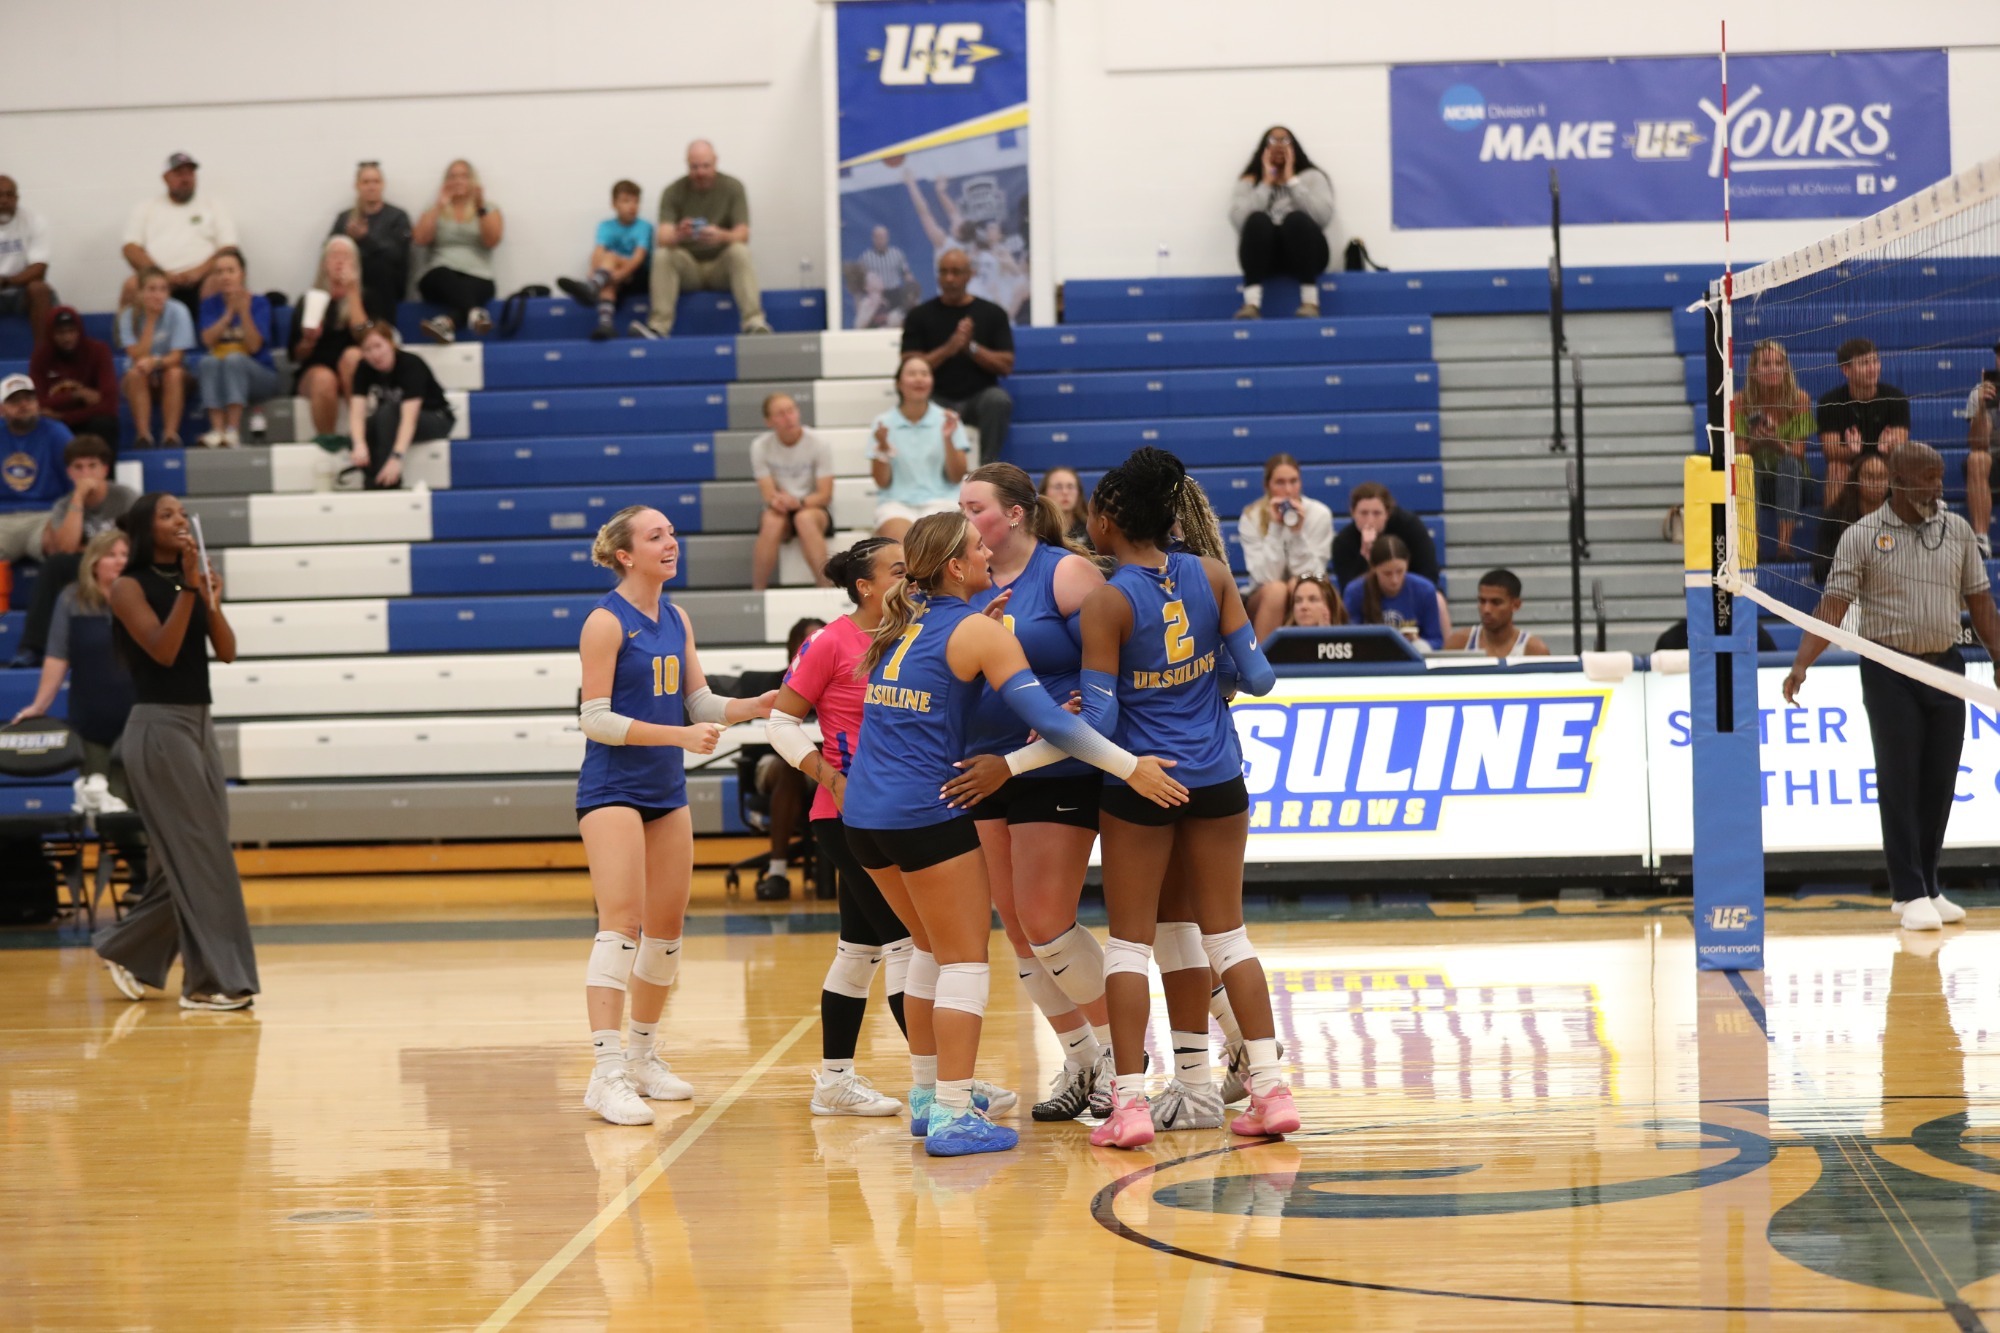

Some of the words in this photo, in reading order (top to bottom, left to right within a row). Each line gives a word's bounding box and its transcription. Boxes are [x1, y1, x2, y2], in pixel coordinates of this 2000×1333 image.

[880, 23, 983, 85] UC
[1443, 106, 1486, 120] NCAA
[1488, 103, 1535, 119] Division
[1479, 121, 1616, 162] MAKE
[1634, 121, 1693, 159] UC
[1698, 84, 1892, 178] YOURS
[1162, 599, 1195, 665] 2
[883, 623, 925, 682] 7
[1317, 642, 1353, 660] POSS
[652, 655, 680, 696] 10
[863, 683, 932, 713] RSULINE
[1232, 701, 1595, 794] SULINE
[1249, 798, 1426, 827] ARROWS
[1712, 907, 1748, 929] UC
[1700, 945, 1726, 955] sports
[1728, 944, 1760, 955] imports
